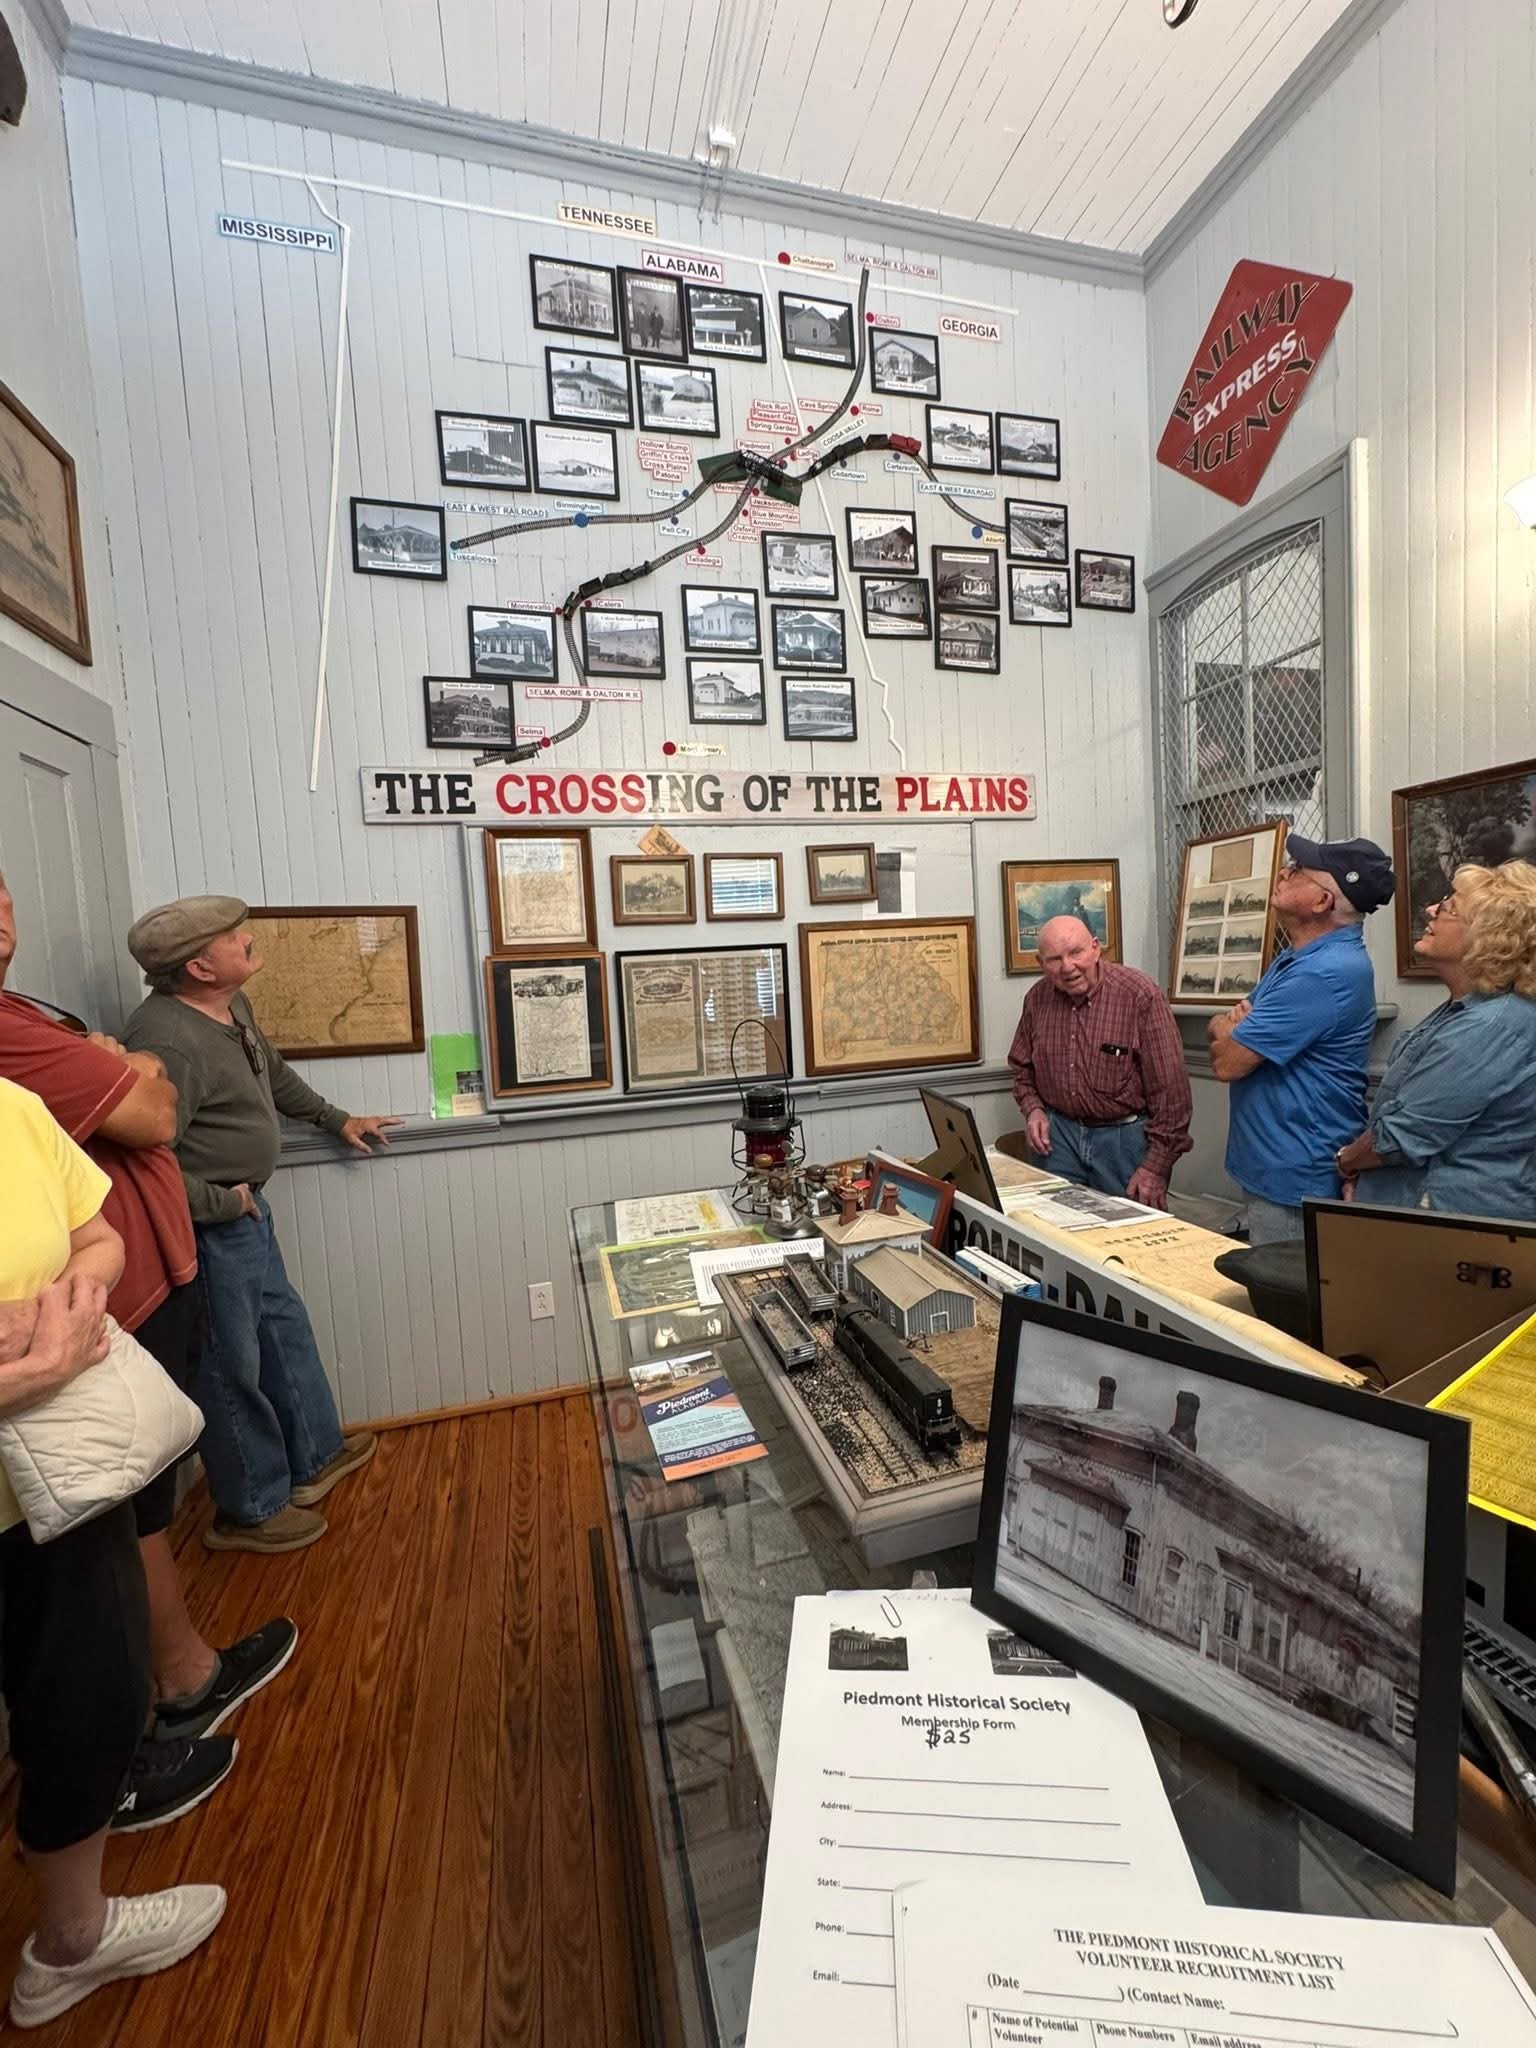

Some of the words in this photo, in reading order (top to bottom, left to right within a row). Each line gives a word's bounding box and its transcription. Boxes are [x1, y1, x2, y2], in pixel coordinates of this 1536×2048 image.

[561, 205, 654, 235] TENNESSEE
[222, 217, 333, 251] MISSISSIPPI
[646, 254, 720, 279] ALABAMA
[942, 318, 998, 339] GEORGIA
[1173, 282, 1319, 424] RAILWAY
[1193, 328, 1298, 435] EXPRESS
[862, 405, 880, 414] Rome
[1176, 336, 1316, 474] AGENCY
[750, 421, 772, 431] Spring
[773, 424, 797, 433] Garden
[640, 441, 665, 450] Hollow
[667, 443, 689, 453] Stump
[644, 460, 662, 469] Cross
[665, 463, 688, 471] Plains
[656, 471, 680, 480] Patona
[649, 488, 680, 498] Tredegar
[944, 486, 961, 494] WEST
[962, 488, 994, 498] RAILROAD
[478, 505, 500, 514] WEST
[503, 507, 545, 517] RAILROAD
[556, 500, 601, 511] Birmingham
[752, 510, 767, 518] Blue
[768, 512, 798, 521] Mountain
[452, 552, 497, 564] Tuscaloosa
[597, 600, 622, 609] Calera
[560, 689, 582, 698] ROME
[585, 689, 591, 698] &
[593, 690, 624, 699] DALTON
[519, 727, 543, 736] Selma
[375, 773, 477, 815] THE
[496, 774, 724, 815] CROSSING
[743, 774, 791, 813] OF
[806, 776, 882, 812] THE
[895, 776, 1028, 813] PLAINS
[656, 1387, 711, 1416] Piedmont
[671, 1393, 717, 1415] ALABAMA
[843, 1691, 923, 1707] Piedmont
[927, 1693, 1006, 1710] Historical
[1009, 1696, 1071, 1715] Society
[901, 1715, 979, 1730] Membership
[983, 1718, 1016, 1730] Form
[925, 1719, 971, 1749] $25
[822, 1768, 846, 1777] Name:
[821, 1800, 853, 1811] Address:
[819, 1837, 837, 1847] City:
[817, 1877, 841, 1888] State:
[815, 1921, 845, 1933] Phone:
[1053, 1928, 1086, 1945] THE
[1088, 1931, 1171, 1953] PIEDMONT
[1173, 1939, 1274, 1964] HISTORICAL
[1275, 1950, 1345, 1971] SOCIETY
[813, 1970, 840, 1982] Email:
[1075, 1950, 1174, 1974] VOLUNTEER
[1176, 1959, 1296, 1987] RECRUITMENT
[1298, 1972, 1336, 1991] LIST
[987, 1972, 1020, 1990] (Date
[1127, 1986, 1181, 2006] (Contact
[1182, 1993, 1226, 2011] Name:
[992, 2012, 1021, 2027] Name
[1023, 2016, 1033, 2028] of
[1035, 2019, 1079, 2033] Potential
[994, 2028, 1043, 2046] Volunteer
[1096, 2023, 1127, 2037] Phone
[1129, 2027, 1176, 2043] Numbers
[1191, 2032, 1222, 2048] Email
